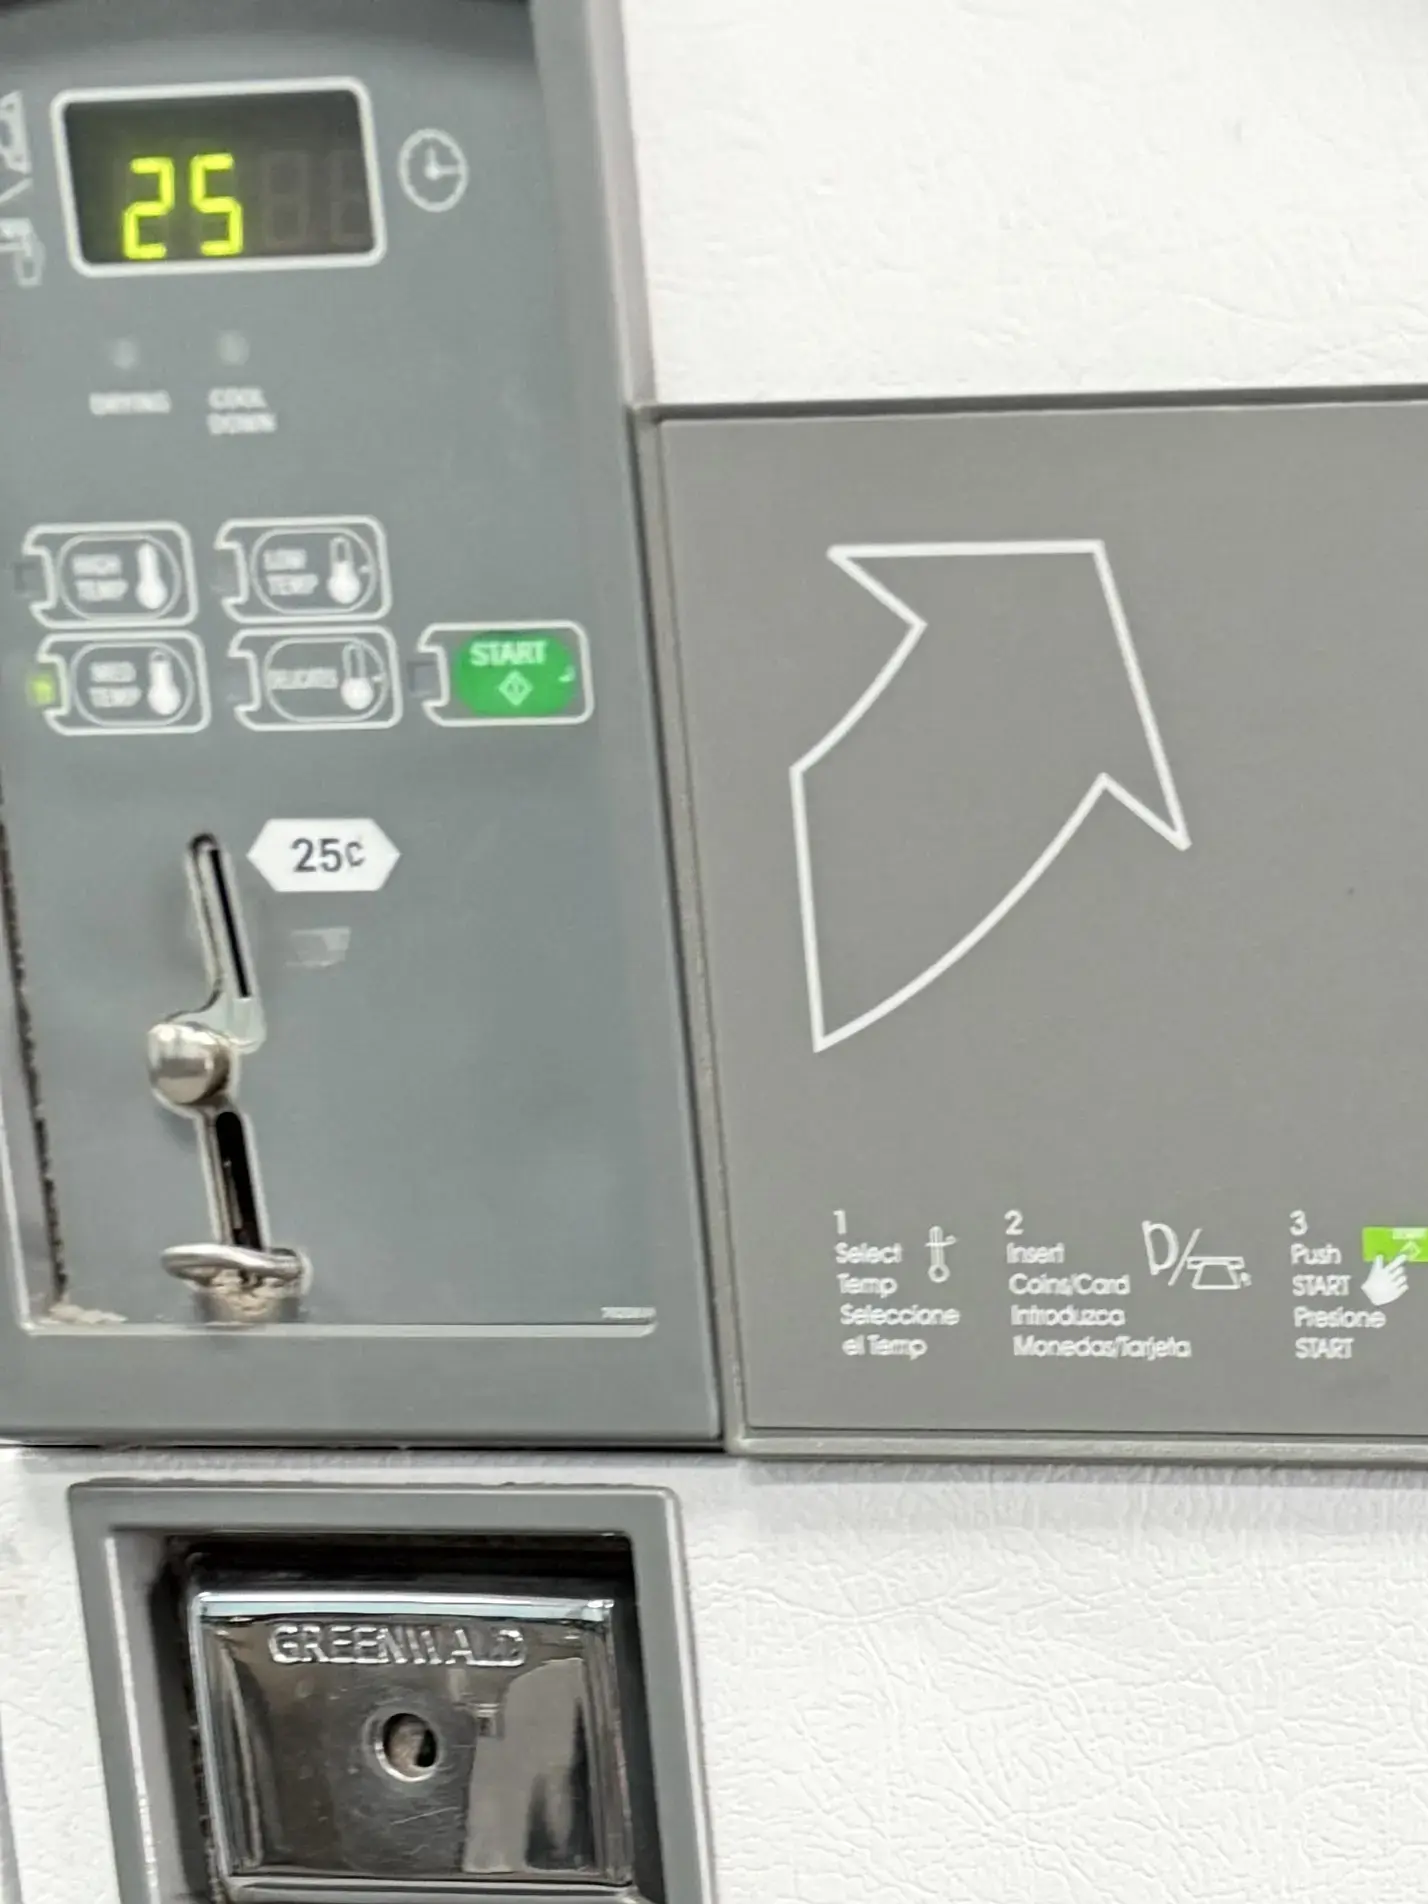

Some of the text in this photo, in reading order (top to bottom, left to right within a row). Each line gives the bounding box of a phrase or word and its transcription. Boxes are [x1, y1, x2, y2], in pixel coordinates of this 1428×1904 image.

[122, 153, 244, 260] 25
[468, 639, 549, 667] START
[290, 838, 366, 873] 25¢
[833, 1209, 847, 1234] 1
[1004, 1209, 1024, 1235] 2
[1289, 1209, 1308, 1236] 3
[834, 1242, 903, 1264] Select
[1006, 1242, 1065, 1264] Insert
[1290, 1243, 1342, 1265] Push
[836, 1272, 898, 1298] Temp
[1008, 1272, 1130, 1296] Coins/Card
[1292, 1274, 1352, 1296] START
[840, 1303, 961, 1325] Seleccione
[1010, 1304, 1126, 1326] Introduzca
[1293, 1306, 1387, 1328] Presione
[841, 1334, 928, 1360] el Temp
[1013, 1334, 1192, 1361] Monedas/Tarjeta
[1295, 1337, 1355, 1359] START
[268, 1624, 526, 1667] GREENWALD
